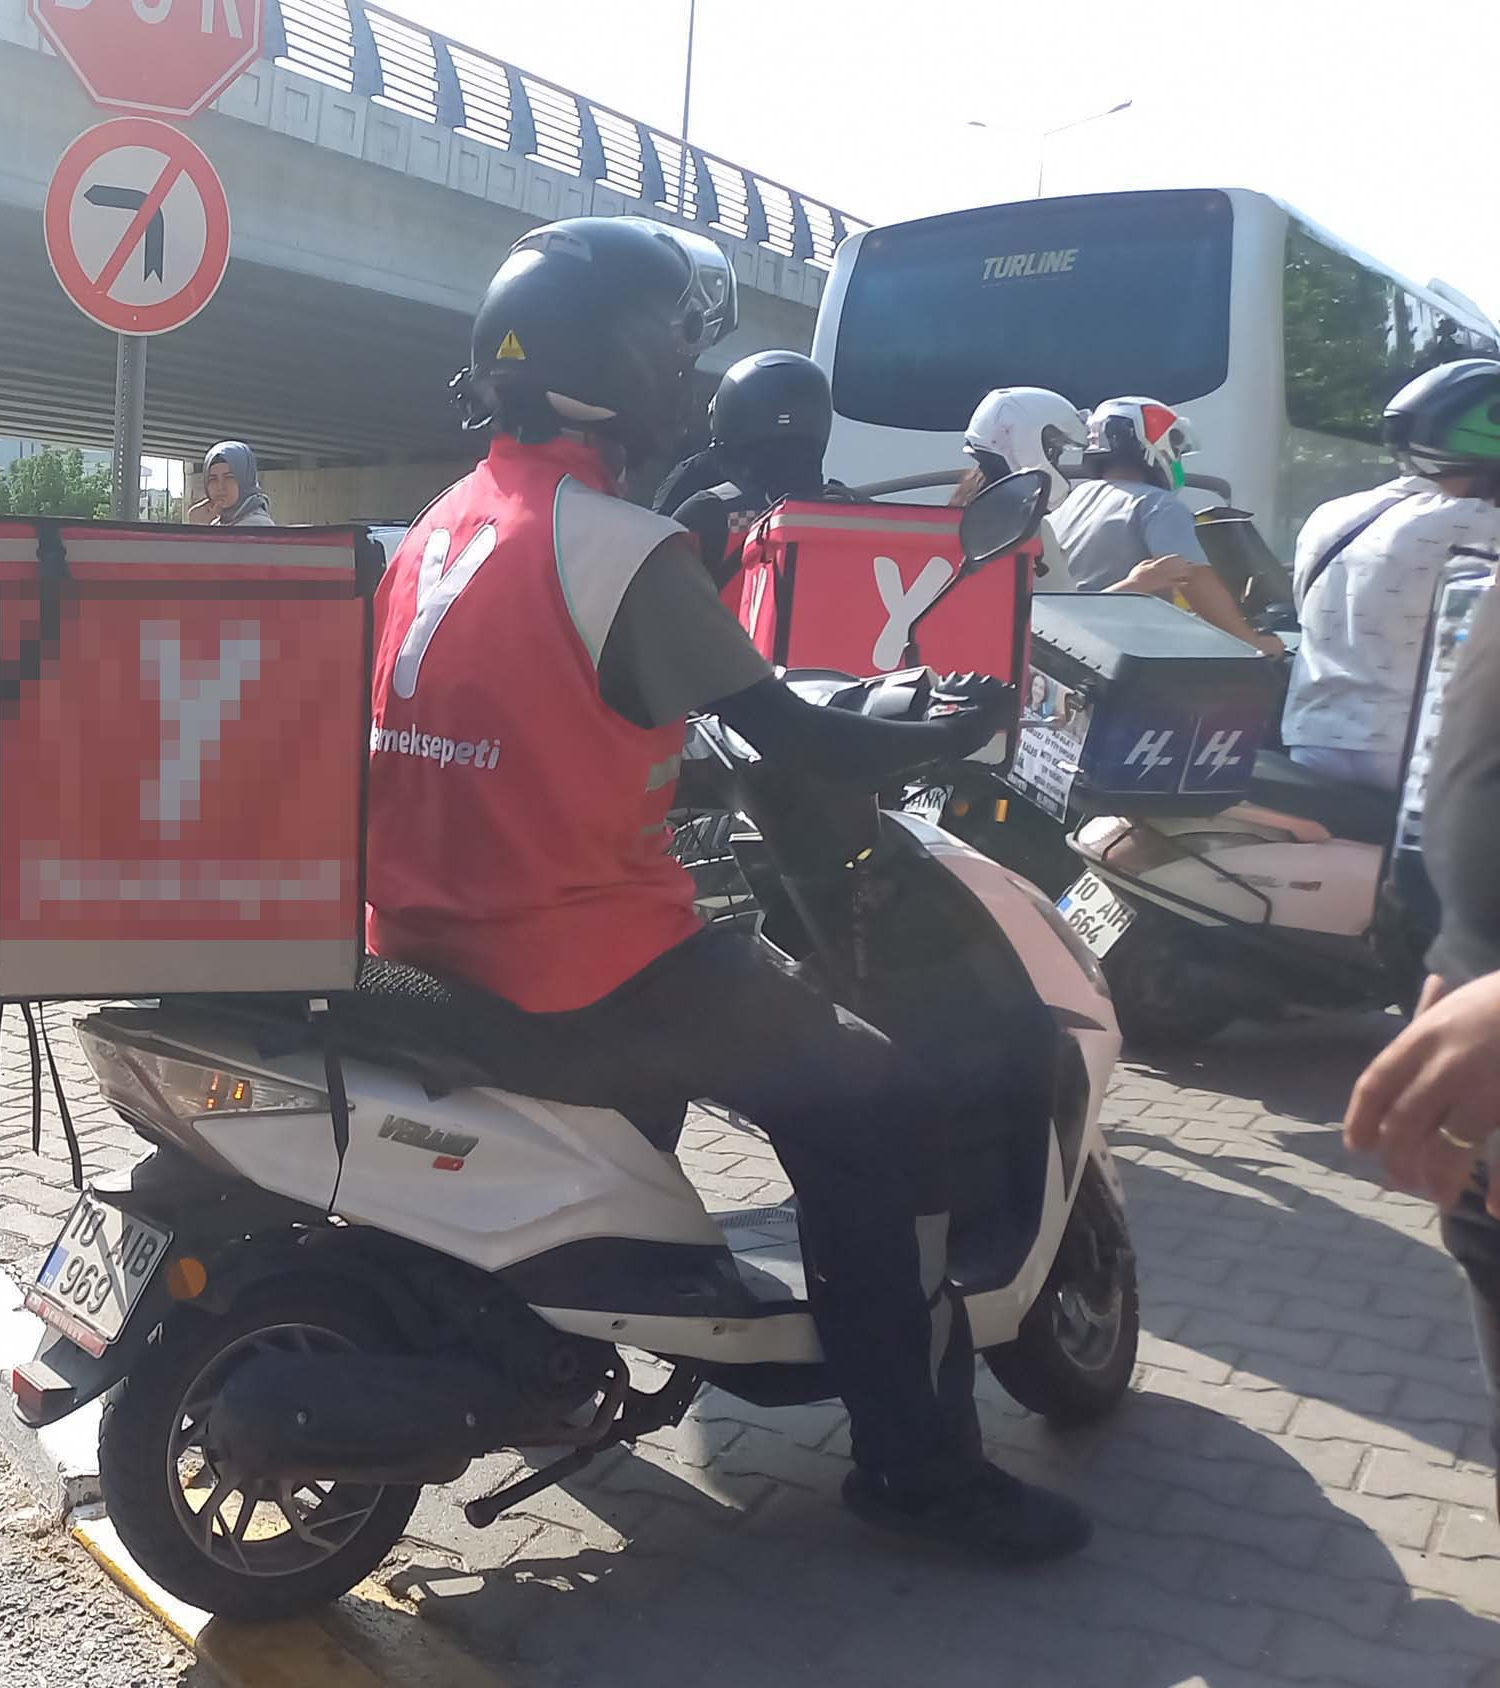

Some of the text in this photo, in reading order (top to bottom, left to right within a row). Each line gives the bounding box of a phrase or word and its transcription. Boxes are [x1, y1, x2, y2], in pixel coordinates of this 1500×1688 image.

[983, 249, 1079, 280] TURLINE
[393, 524, 498, 699] Y
[872, 556, 954, 671] Y
[370, 717, 501, 769] emeksepeti
[1075, 877, 1099, 901] 10
[1069, 908, 1105, 944] 664
[71, 1202, 106, 1247] 10
[60, 1255, 113, 1314] 969
